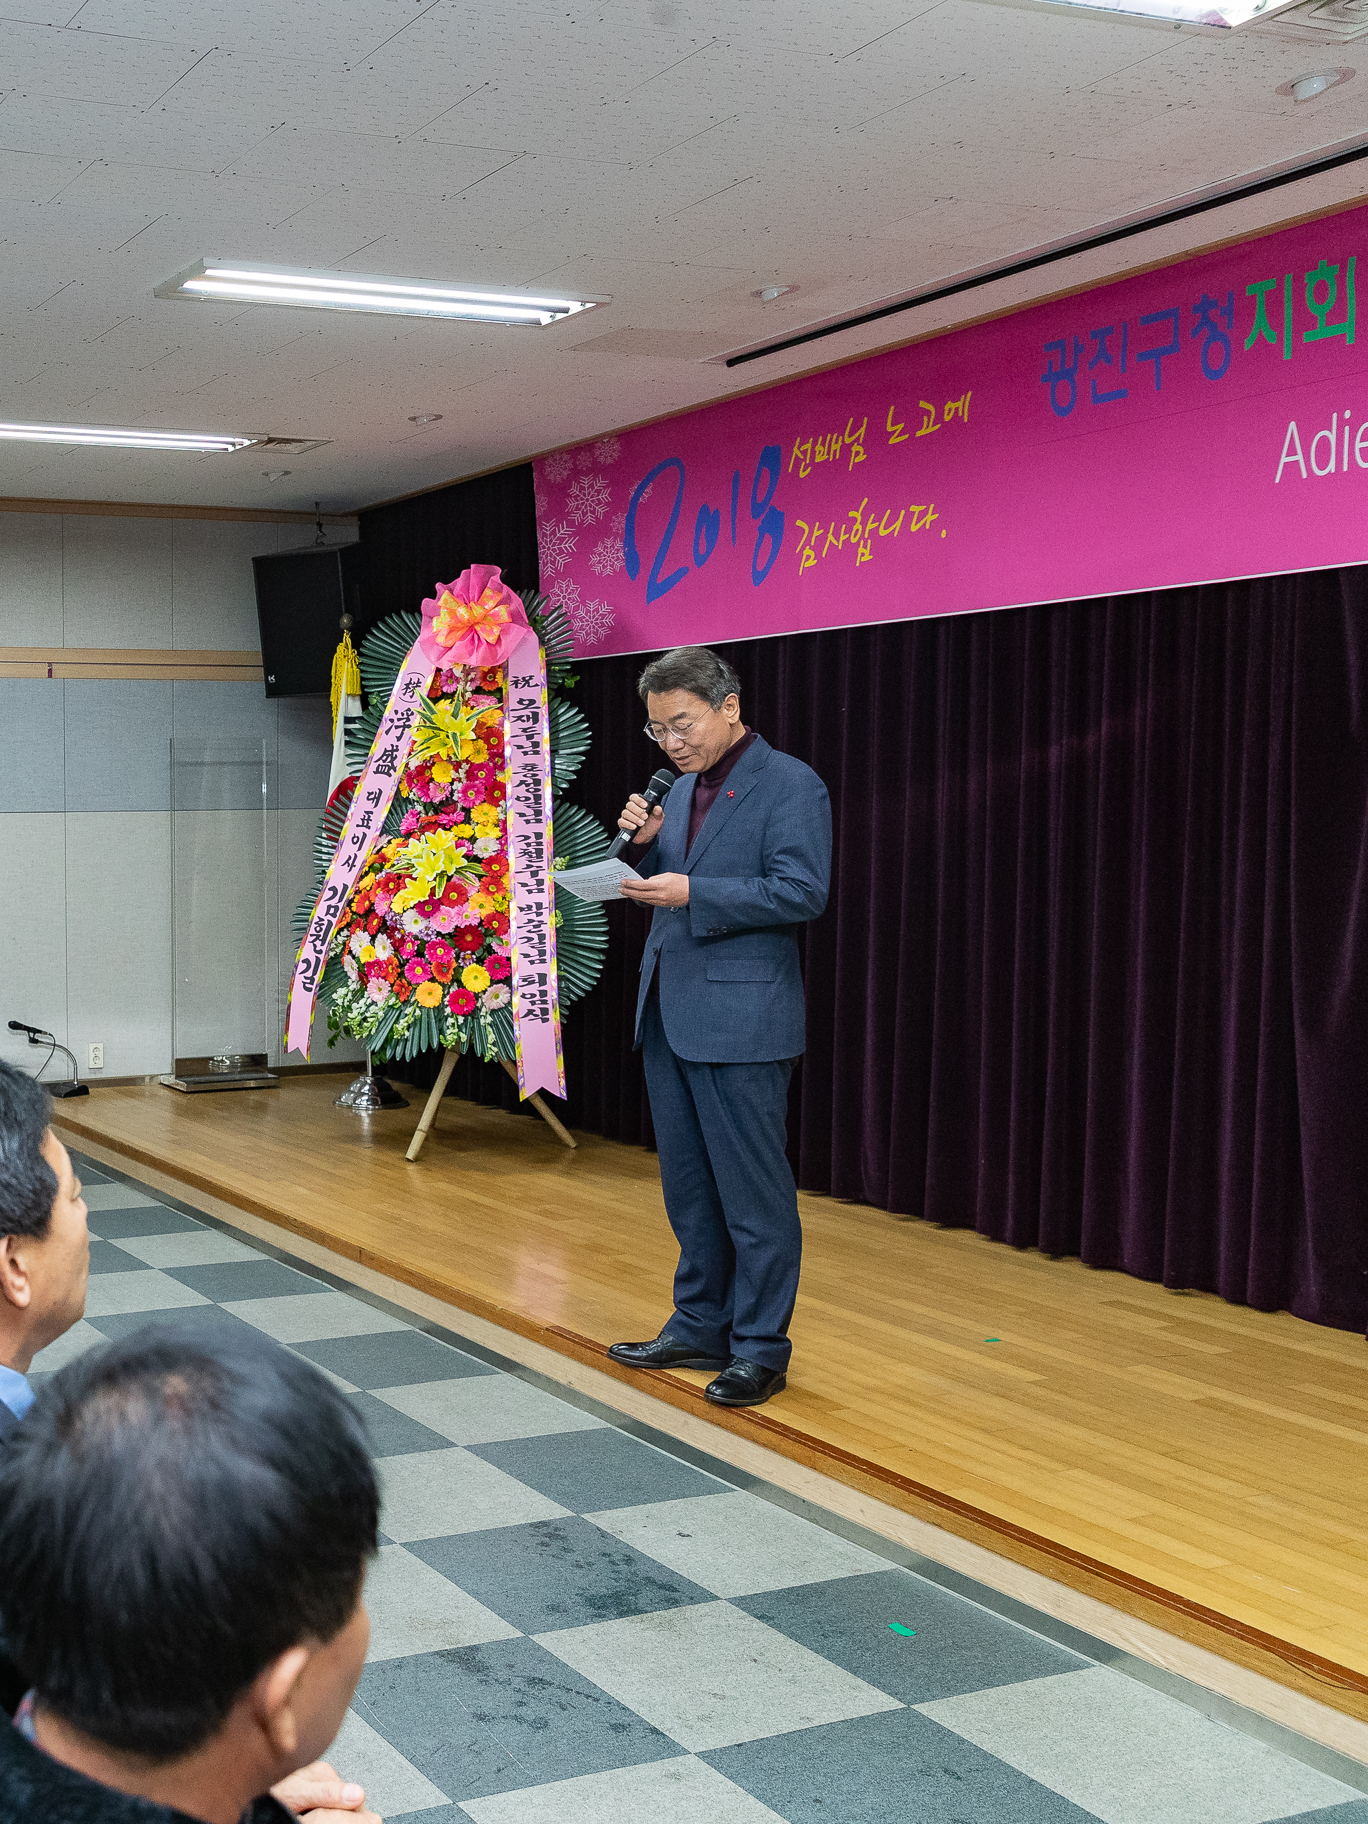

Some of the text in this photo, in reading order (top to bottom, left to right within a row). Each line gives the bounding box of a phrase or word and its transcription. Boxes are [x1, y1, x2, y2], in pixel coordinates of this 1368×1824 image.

[788, 391, 972, 478] 선배님 노고에
[624, 444, 785, 607] 2018
[795, 497, 947, 576] 감사합니다.
[509, 675, 540, 689] 祝
[341, 787, 383, 875] 대표이사
[518, 972, 550, 1024] 퇴임식
